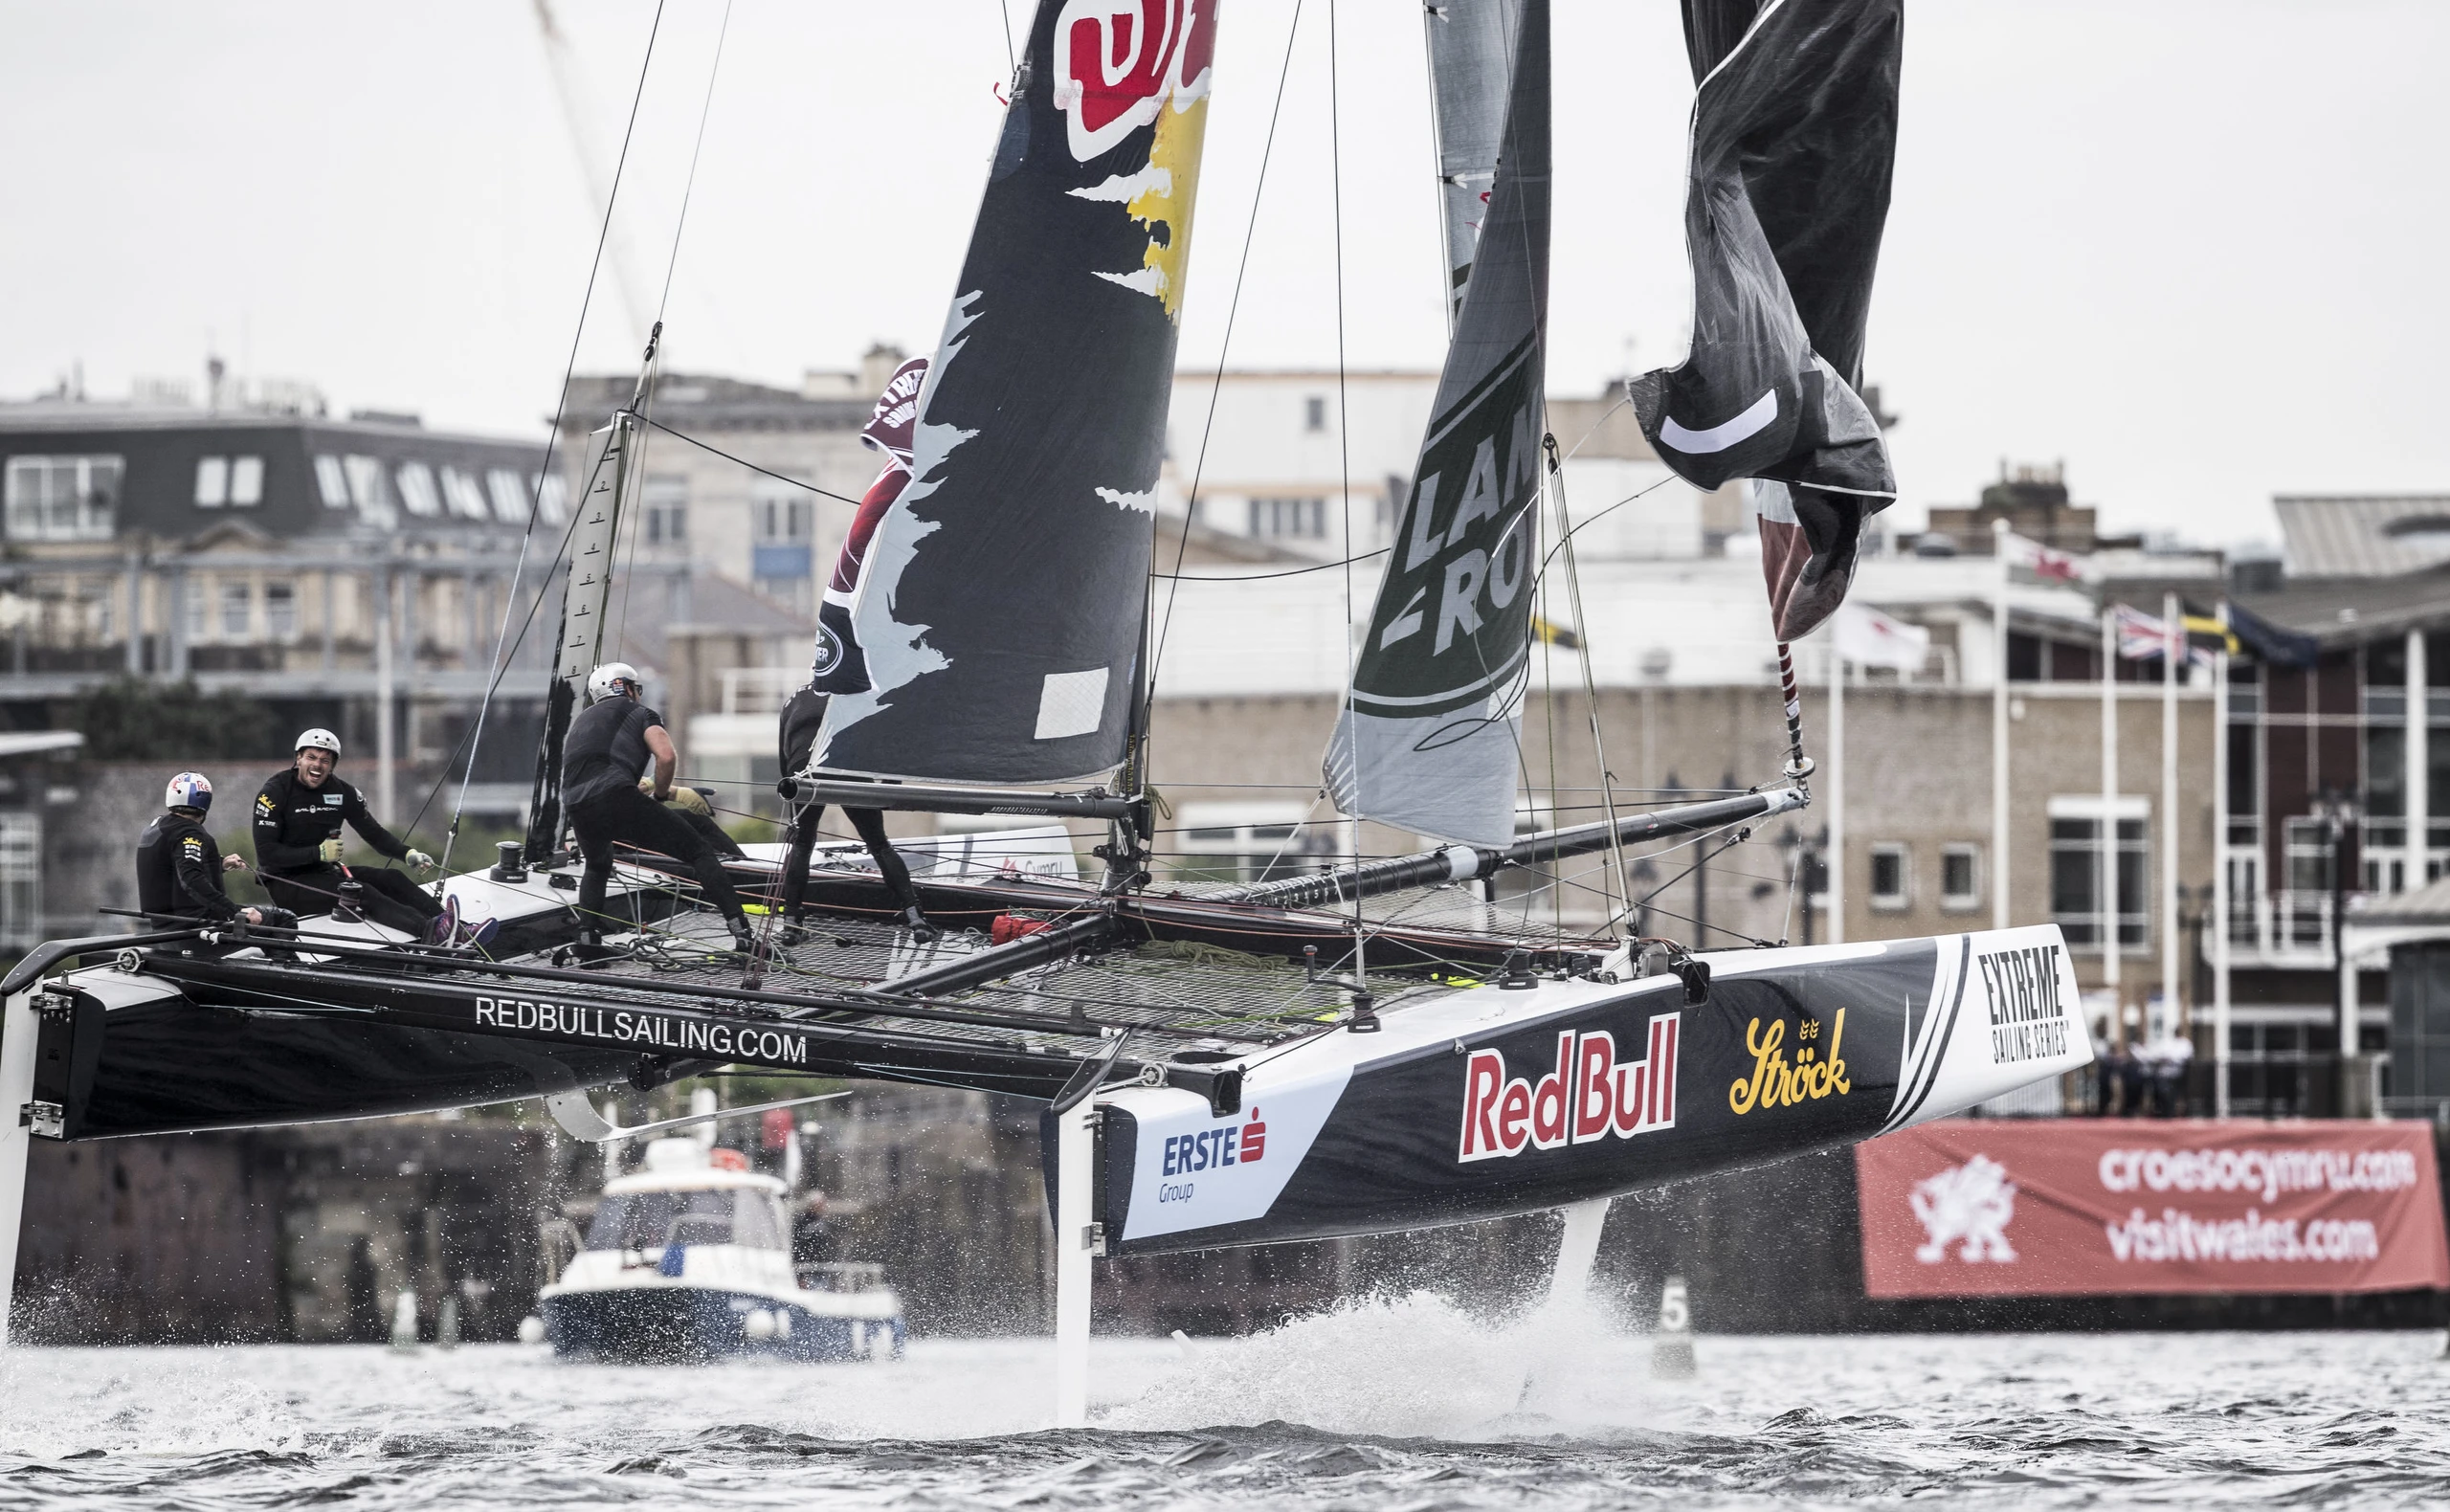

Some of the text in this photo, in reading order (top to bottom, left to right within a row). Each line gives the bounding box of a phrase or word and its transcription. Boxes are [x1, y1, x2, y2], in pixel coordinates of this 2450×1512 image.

[601, 480, 607, 490] 2
[595, 512, 602, 522] 3
[586, 573, 591, 583] 5
[581, 605, 587, 613] 6
[1977, 945, 2063, 1026] EXTREME
[476, 996, 808, 1064] REDBULLSAILING.COM
[1992, 1020, 2067, 1064] SAILING SERIES
[1728, 1007, 1851, 1116] Ströck
[1162, 1125, 1238, 1177] ERSTE
[1159, 1182, 1194, 1204] Group
[2098, 1149, 2417, 1203] croesocymru.com
[2105, 1207, 2379, 1262] visitwales.com
[1660, 1285, 1688, 1331] 5
